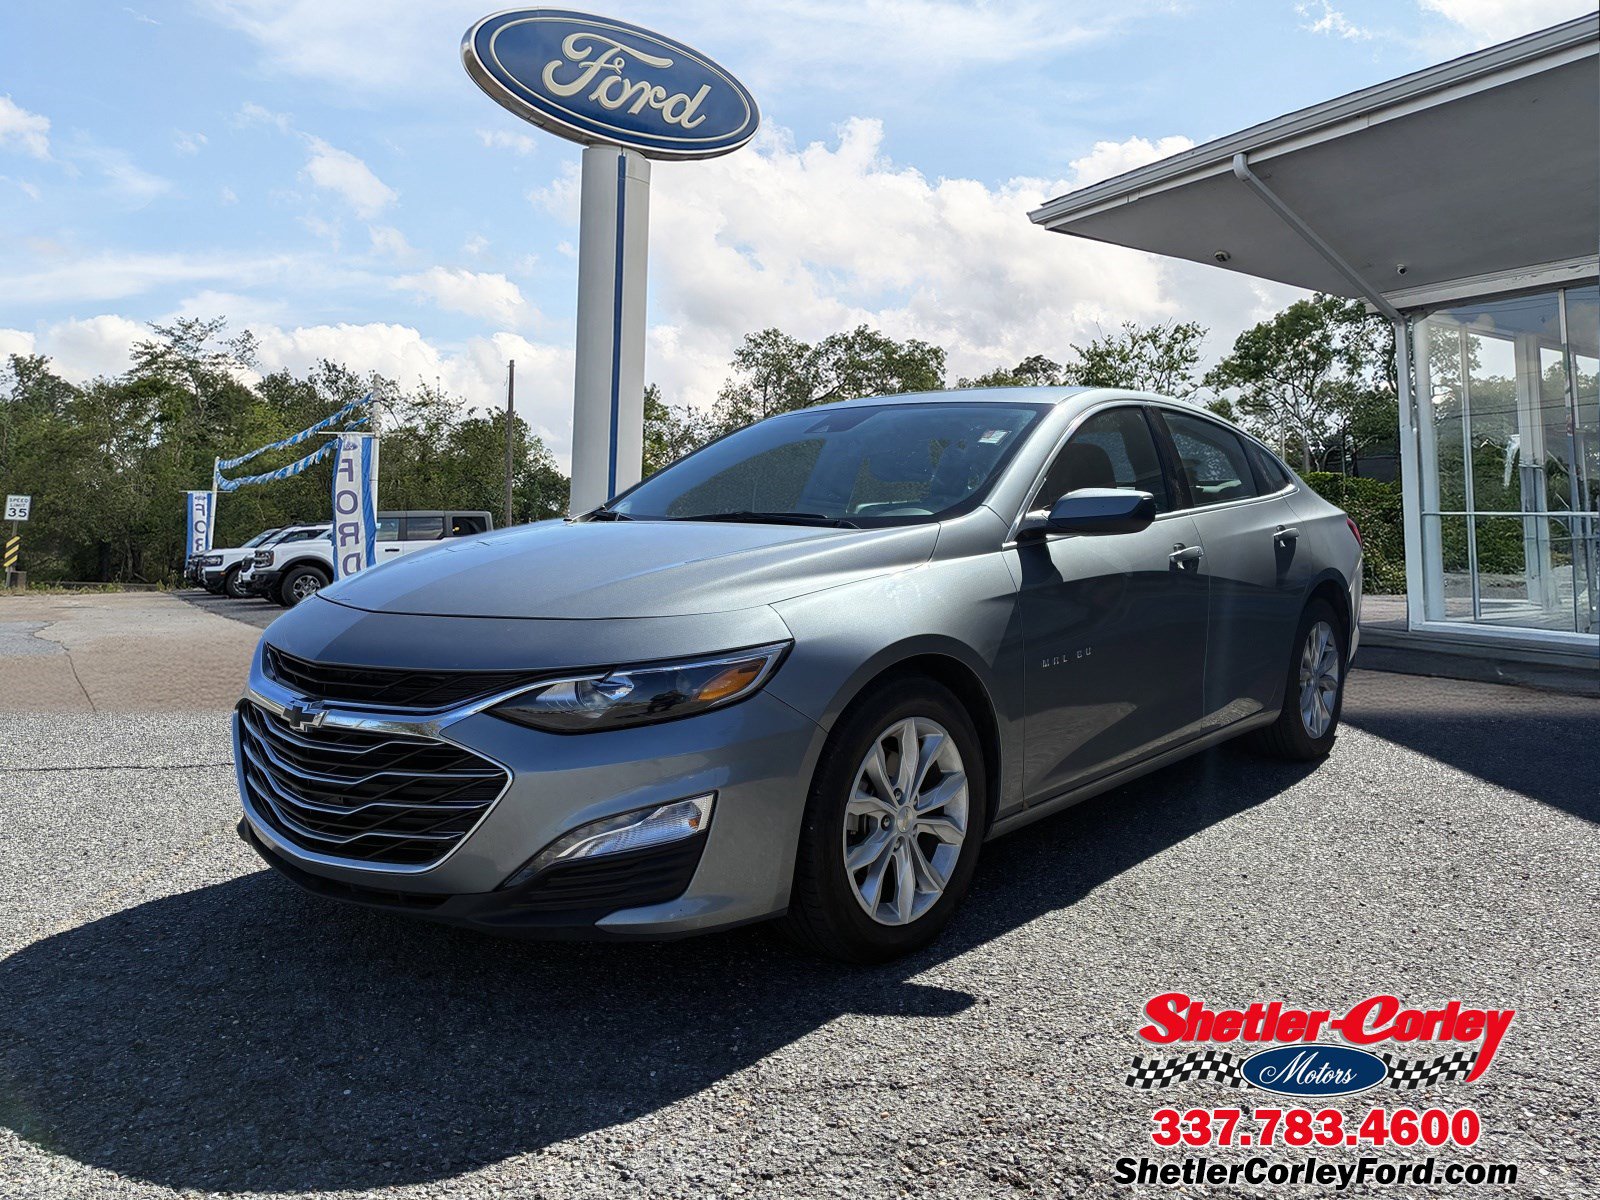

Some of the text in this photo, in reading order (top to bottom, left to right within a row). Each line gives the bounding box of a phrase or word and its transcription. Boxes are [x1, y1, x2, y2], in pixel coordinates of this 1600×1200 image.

[541, 32, 712, 129] Ford
[8, 507, 27, 517] 35
[1042, 647, 1092, 668] MALBU
